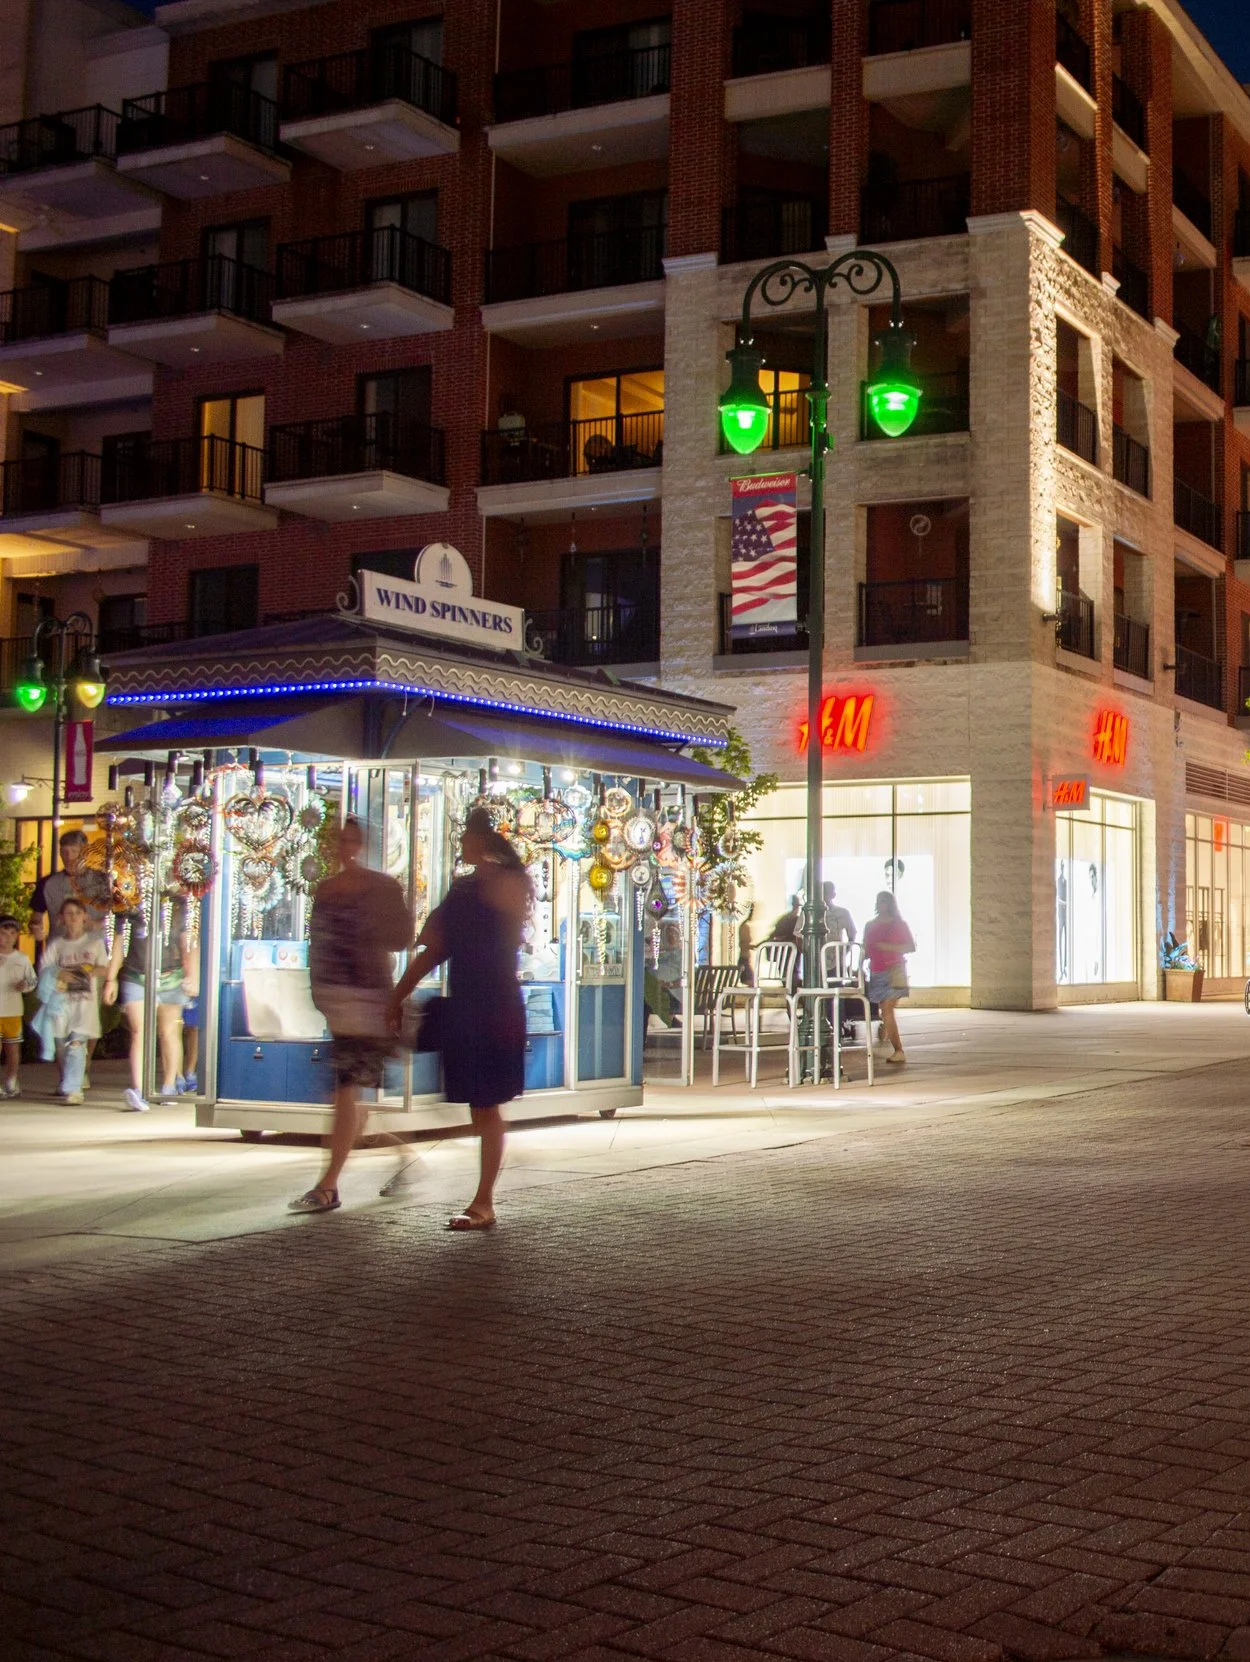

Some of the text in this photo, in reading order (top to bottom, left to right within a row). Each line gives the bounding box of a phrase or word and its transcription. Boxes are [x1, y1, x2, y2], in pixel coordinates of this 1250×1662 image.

[736, 477, 791, 493] Budweiser
[376, 587, 513, 634] WIND SPINNERS
[1093, 709, 1128, 768] H&M
[1054, 780, 1086, 805] H&M
